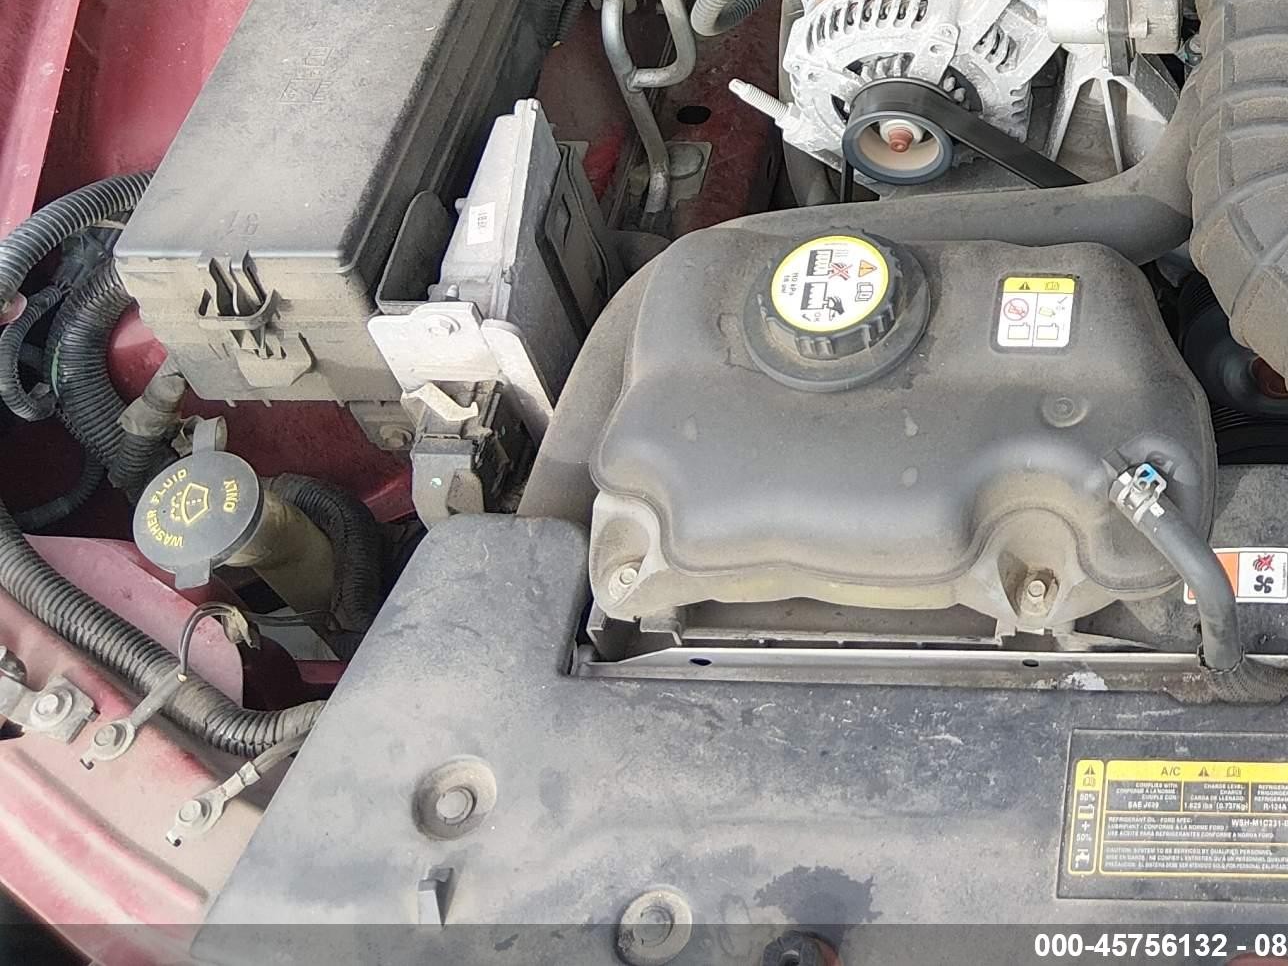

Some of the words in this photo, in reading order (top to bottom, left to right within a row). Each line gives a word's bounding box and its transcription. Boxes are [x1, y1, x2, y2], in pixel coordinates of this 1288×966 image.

[151, 468, 187, 505] FLUID
[223, 478, 239, 513] ONLY
[146, 510, 184, 547] WASHER
[1161, 766, 1181, 776] A/C
[1128, 801, 1142, 809] SAE
